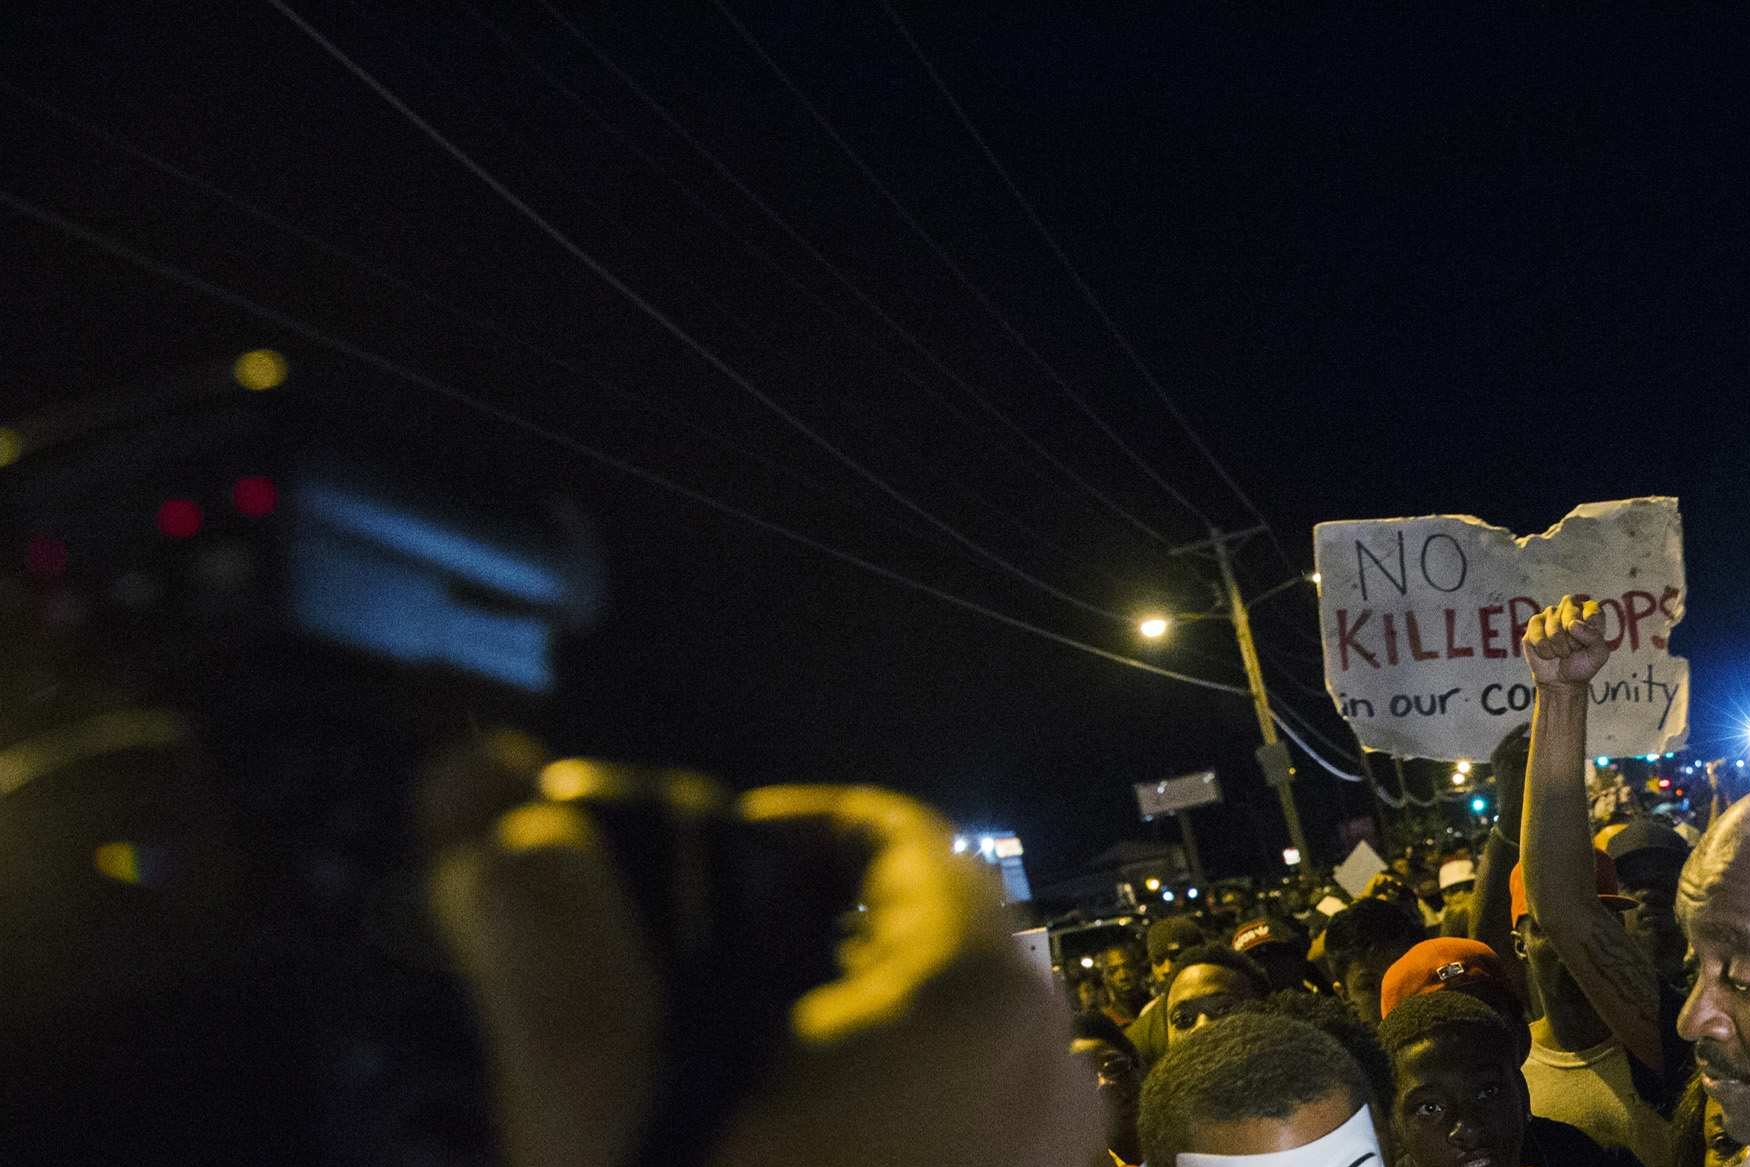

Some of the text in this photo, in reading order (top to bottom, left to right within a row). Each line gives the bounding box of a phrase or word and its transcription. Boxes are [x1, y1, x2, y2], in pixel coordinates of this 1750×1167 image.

[1355, 531, 1468, 601] NO
[1339, 664, 1680, 731] in our counity
